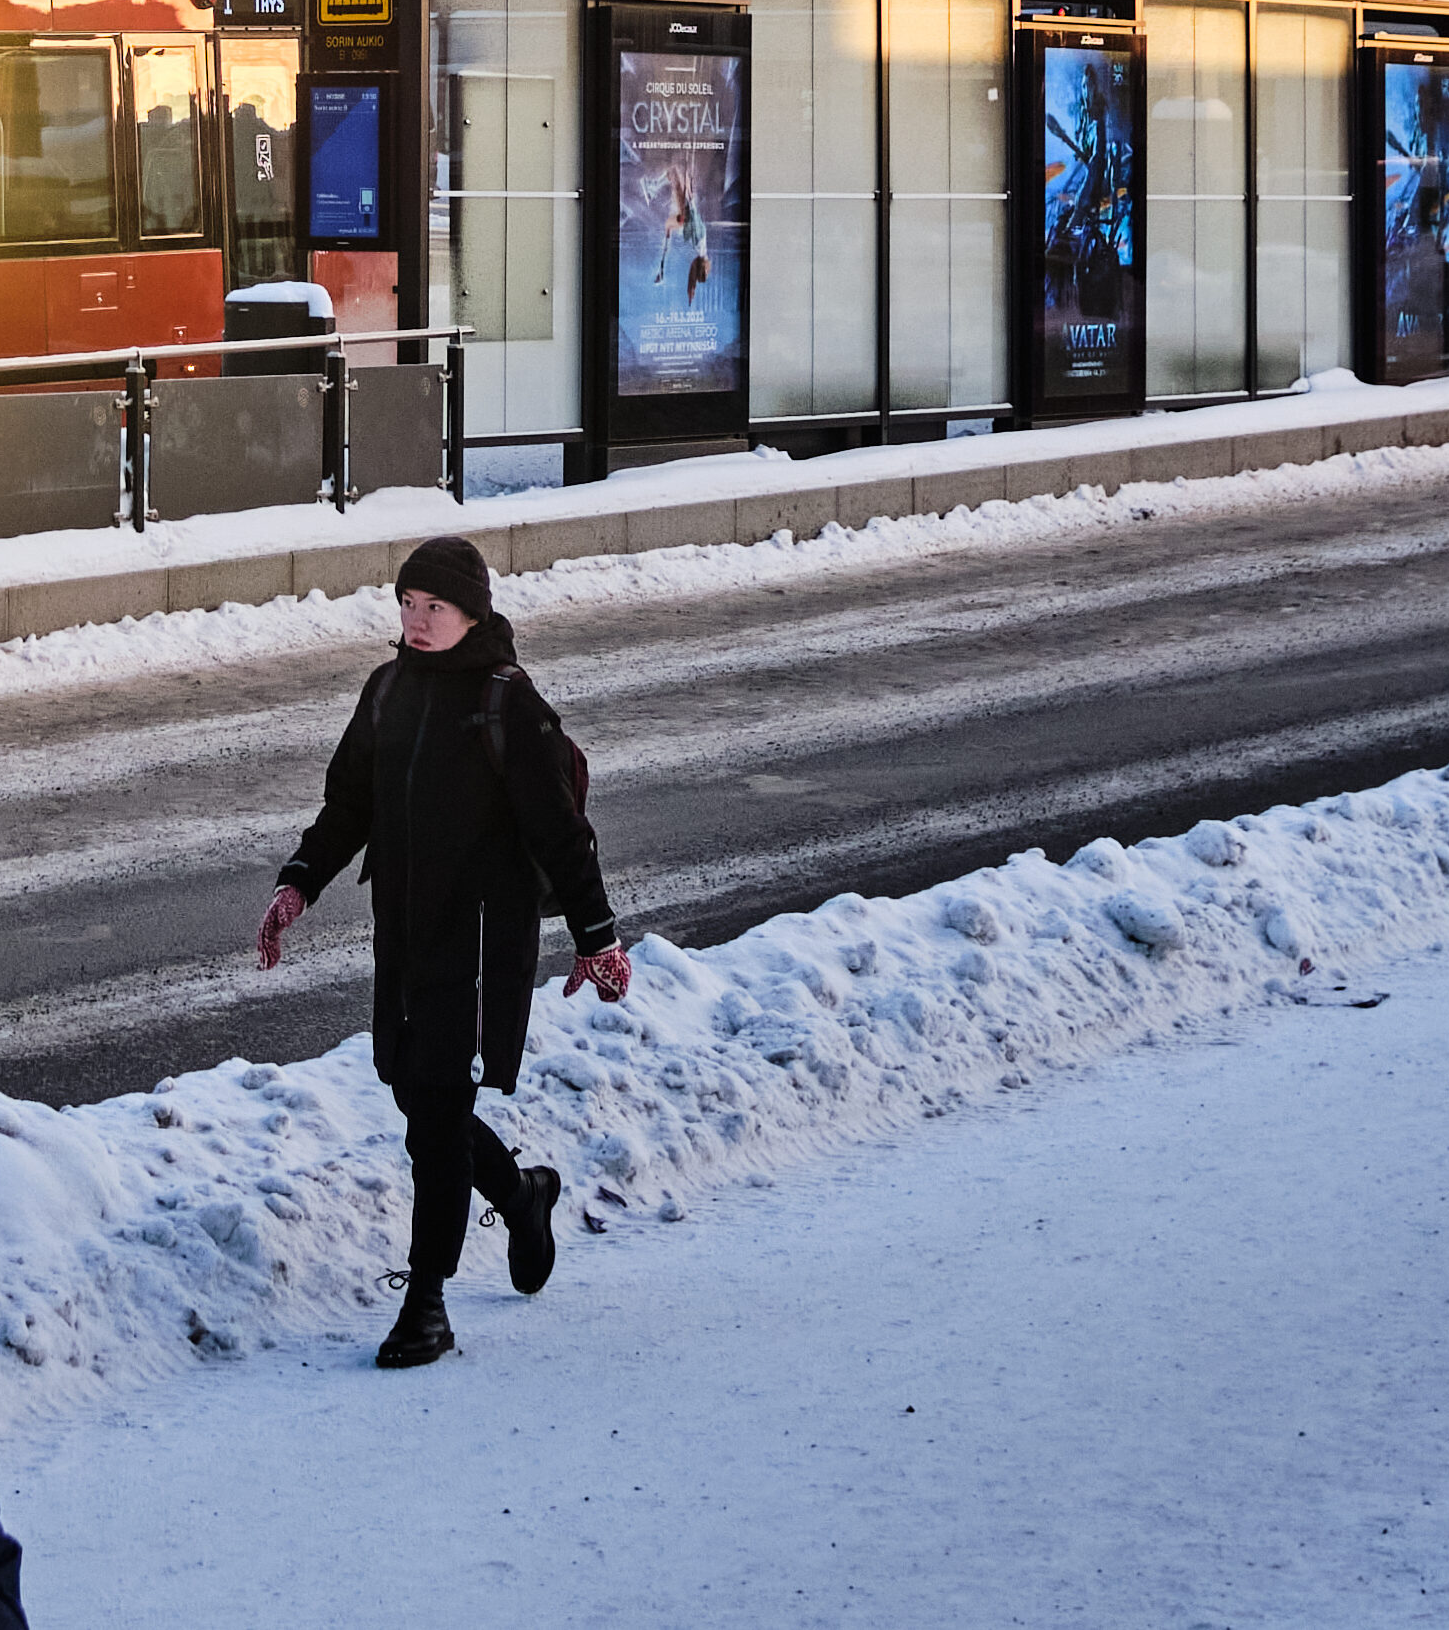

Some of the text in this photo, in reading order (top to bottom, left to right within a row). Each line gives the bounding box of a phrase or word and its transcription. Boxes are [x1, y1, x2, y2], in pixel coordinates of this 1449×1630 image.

[325, 35, 385, 48] SORIN AUKIO
[645, 81, 714, 97] CIRQUE DU SOLEIL
[632, 101, 725, 134] CRYSTAL
[1061, 321, 1117, 351] AVATAR
